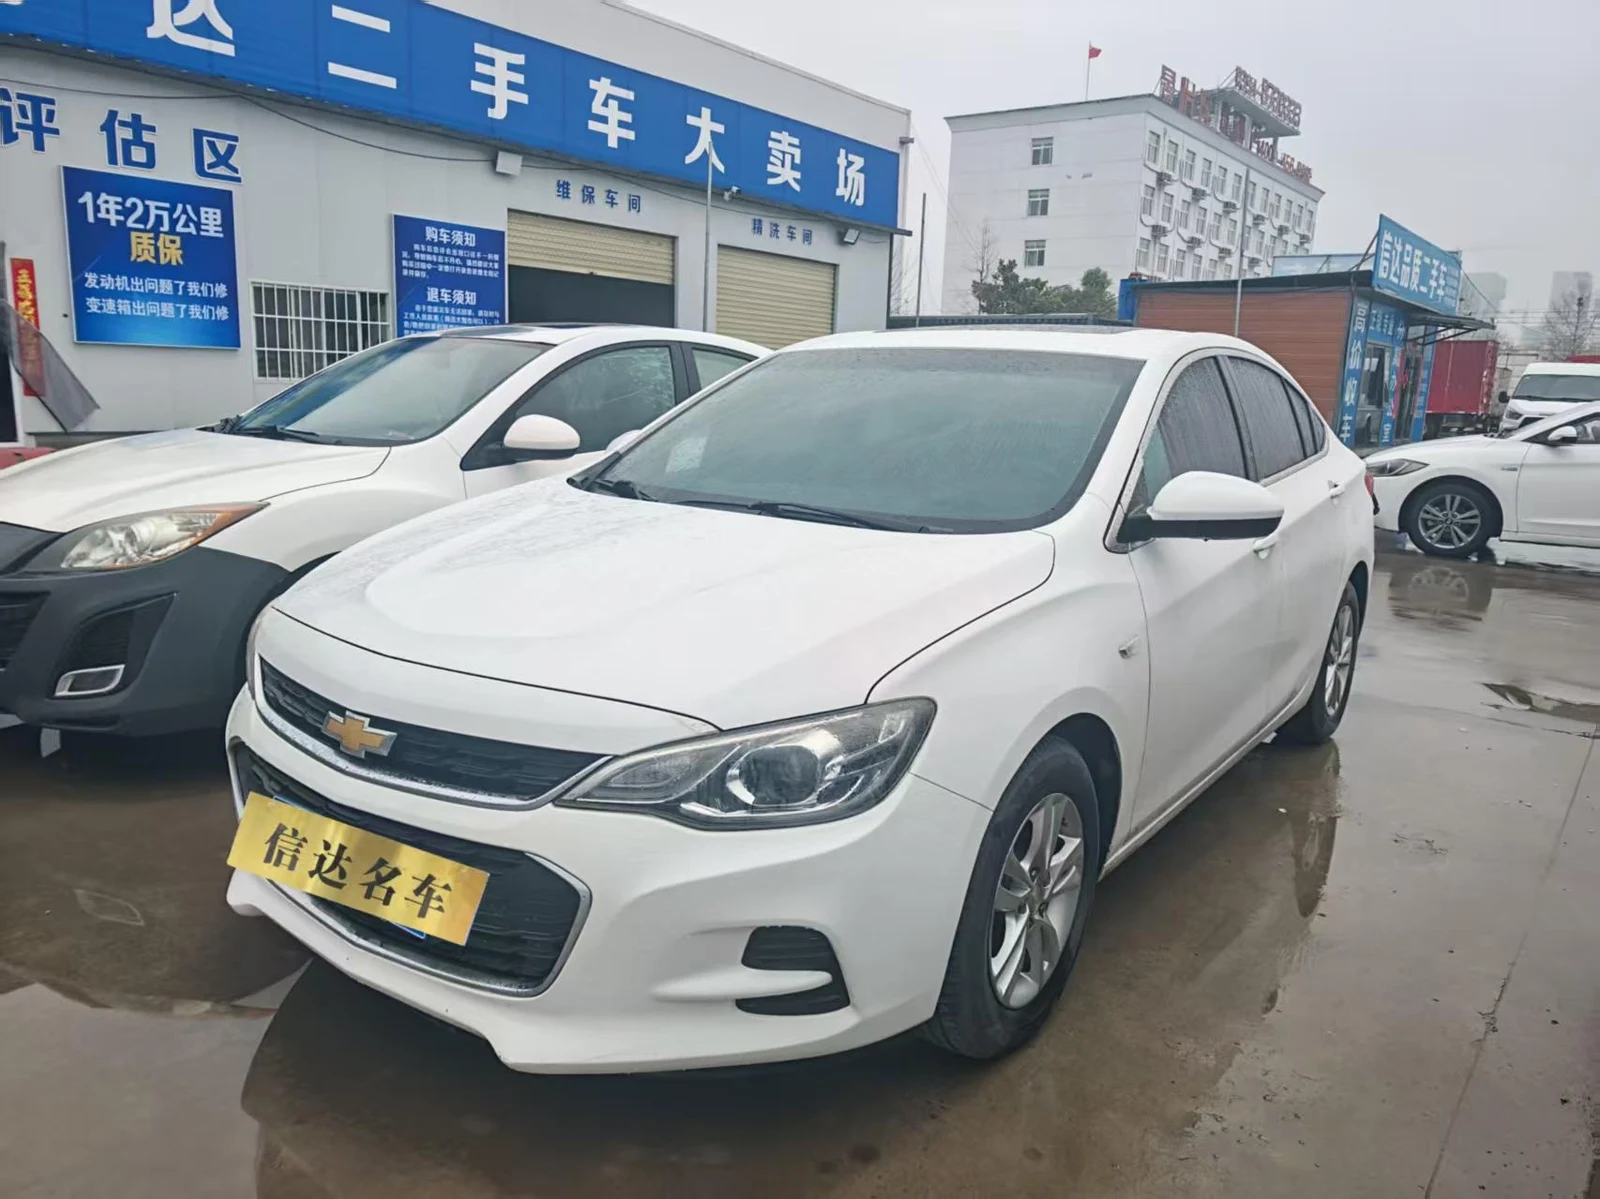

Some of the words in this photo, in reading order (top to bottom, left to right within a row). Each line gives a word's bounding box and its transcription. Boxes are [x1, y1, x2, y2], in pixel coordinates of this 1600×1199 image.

[0, 0, 865, 206] 达二手车大卖场
[0, 87, 242, 183] 评估区
[556, 179, 641, 213] 维保车间
[78, 191, 224, 238] 1年2万公里
[130, 231, 184, 266] 质保
[425, 226, 476, 247] 购车须知
[752, 218, 813, 246] 精洗车间
[84, 272, 228, 299] 发动机出问题了我们修
[426, 286, 477, 306] 退车须知
[85, 296, 229, 321] 变速箱出问题了我们修
[263, 822, 452, 918] 信达名车
